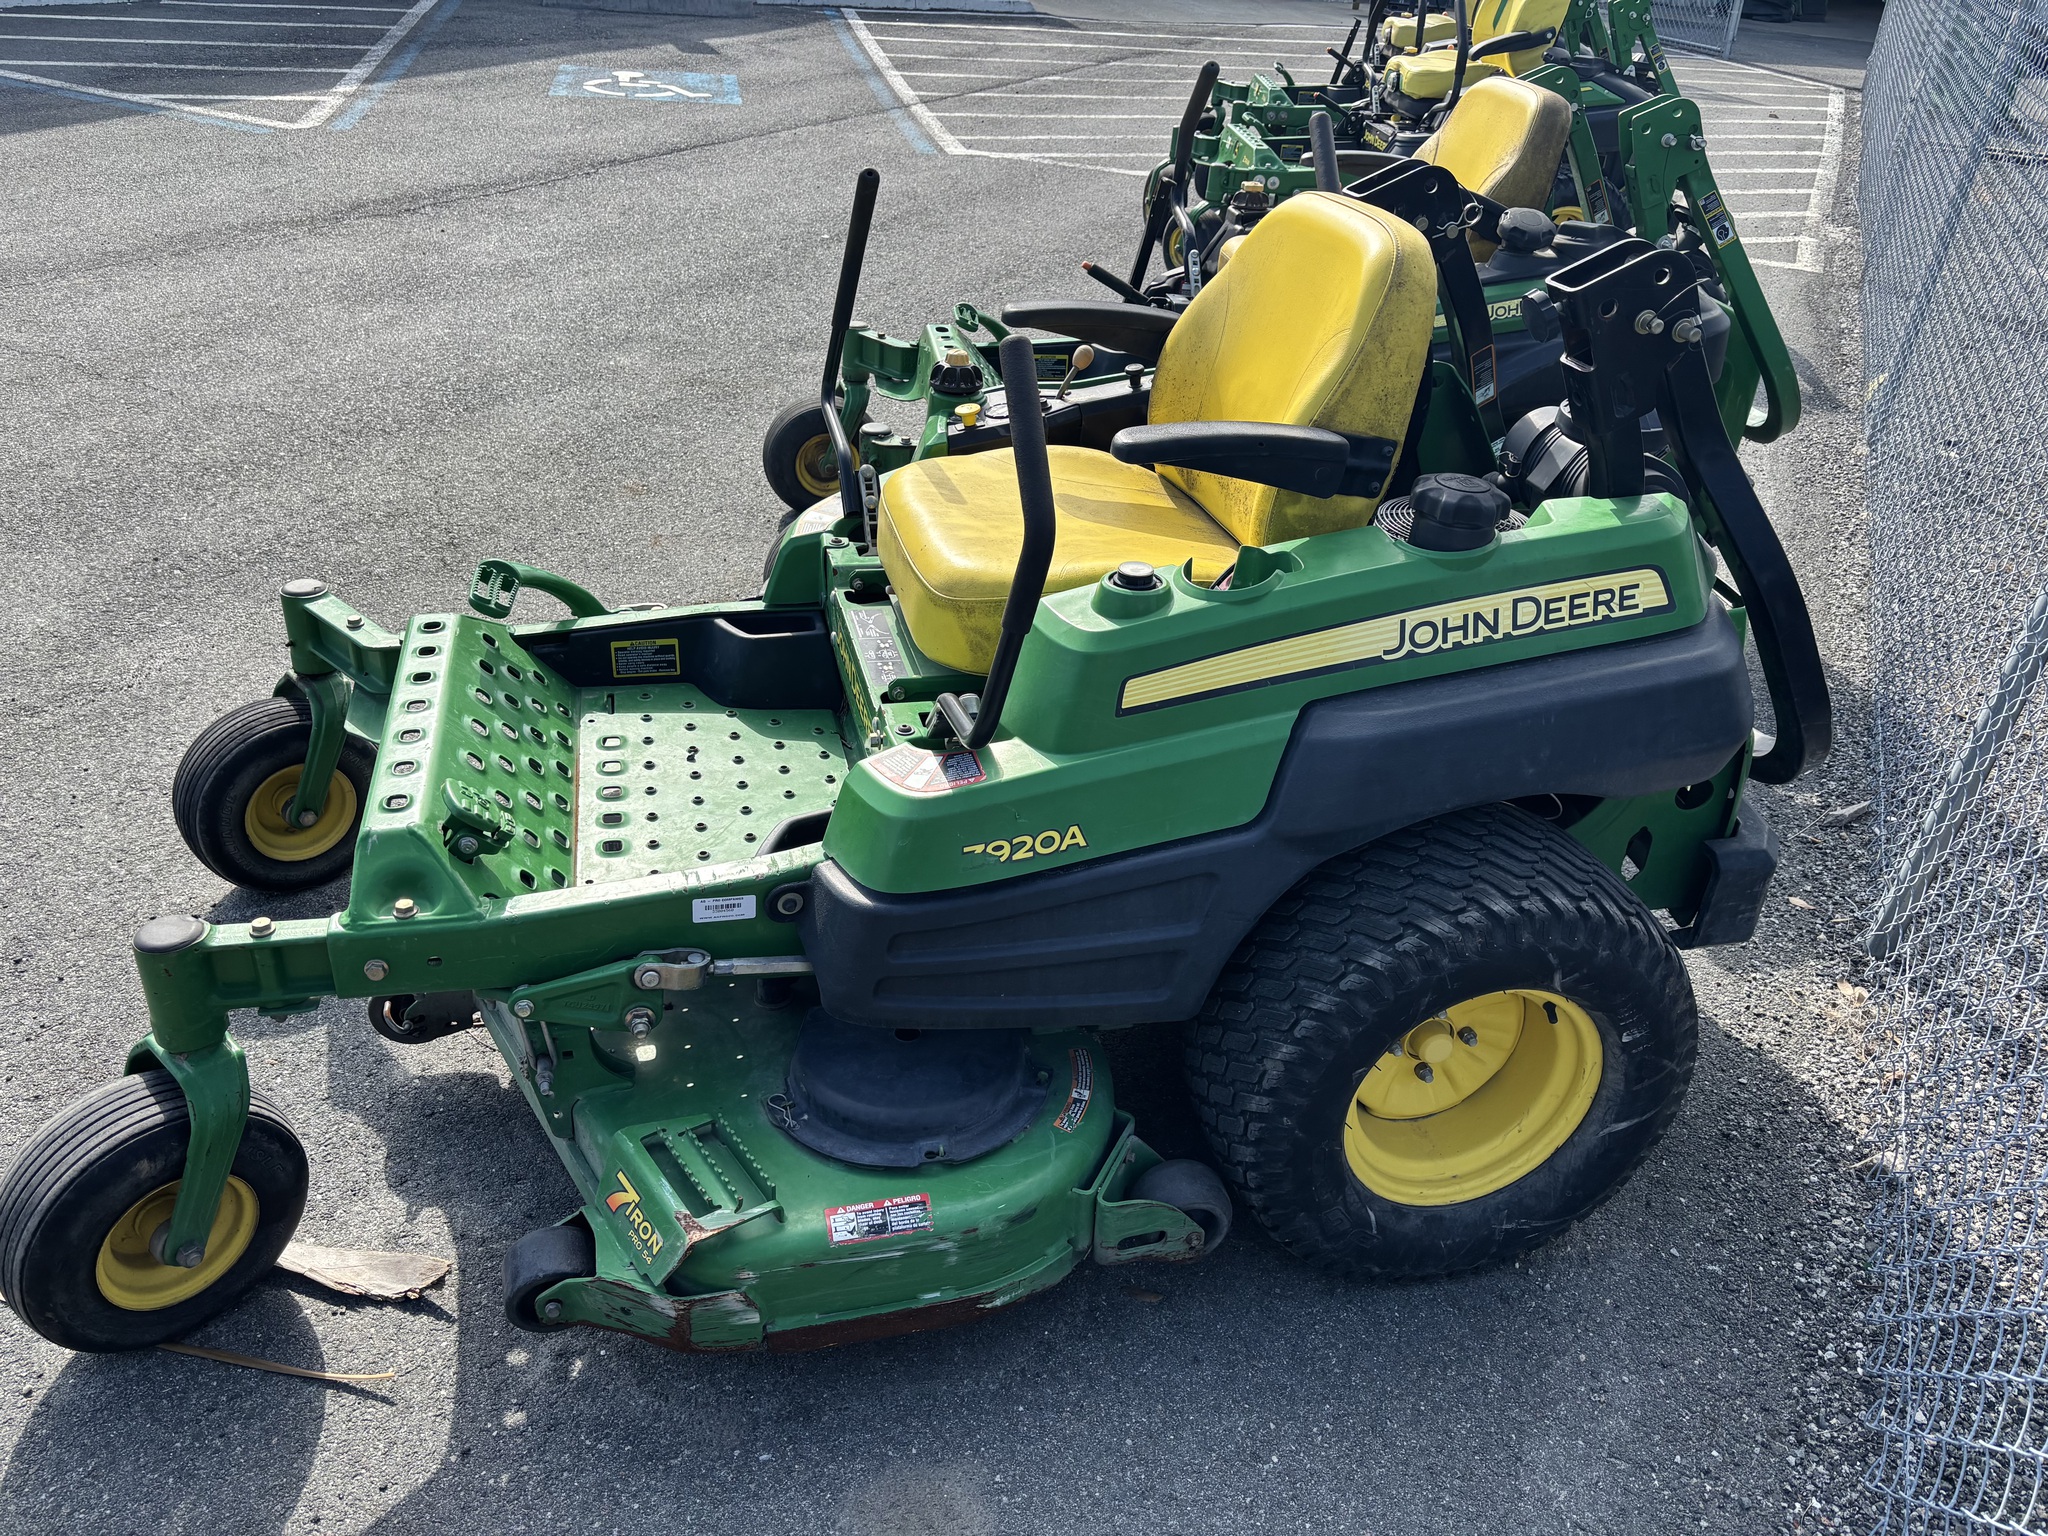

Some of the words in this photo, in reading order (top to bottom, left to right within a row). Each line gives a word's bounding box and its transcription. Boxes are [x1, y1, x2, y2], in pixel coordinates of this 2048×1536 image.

[1489, 302, 1522, 318] JOH
[1382, 607, 1501, 656] JOHN
[1511, 583, 1640, 631] DEERE
[846, 1202, 874, 1212] DANGER
[893, 1194, 921, 1205] PELIGRO
[628, 1229, 643, 1251] PRO
[641, 1249, 653, 1265] 54
